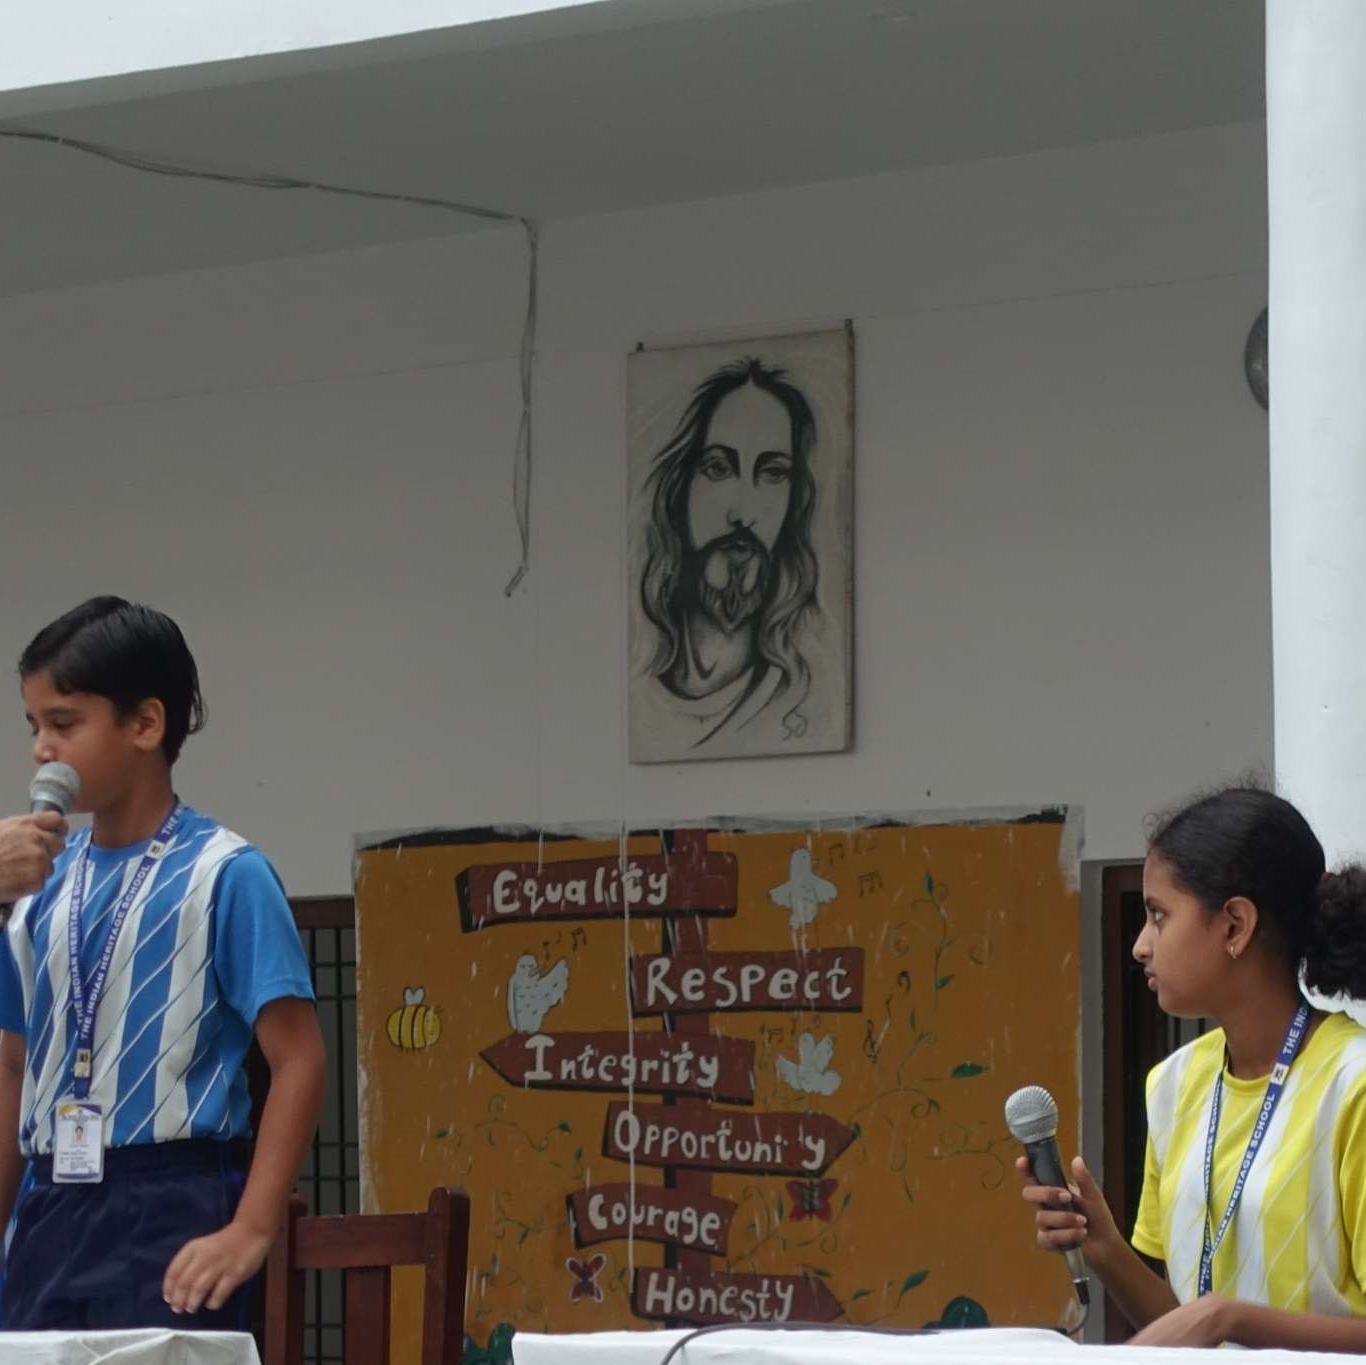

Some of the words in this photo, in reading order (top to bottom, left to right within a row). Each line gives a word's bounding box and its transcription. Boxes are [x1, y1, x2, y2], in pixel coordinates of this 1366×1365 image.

[121, 863, 151, 910] SCHOOL
[493, 862, 668, 914] Equality
[100, 910, 124, 971] HERITAGE
[86, 971, 104, 1015] INDIAN
[647, 956, 852, 1008] Respect
[81, 1016, 92, 1040] THE
[1283, 1029, 1301, 1056] THE
[523, 1034, 719, 1088] Integrity
[615, 1110, 825, 1170] Opportuniy
[1250, 1092, 1276, 1148] SCHOOL
[588, 1193, 721, 1246] Courage
[645, 1272, 794, 1323] Honesty
